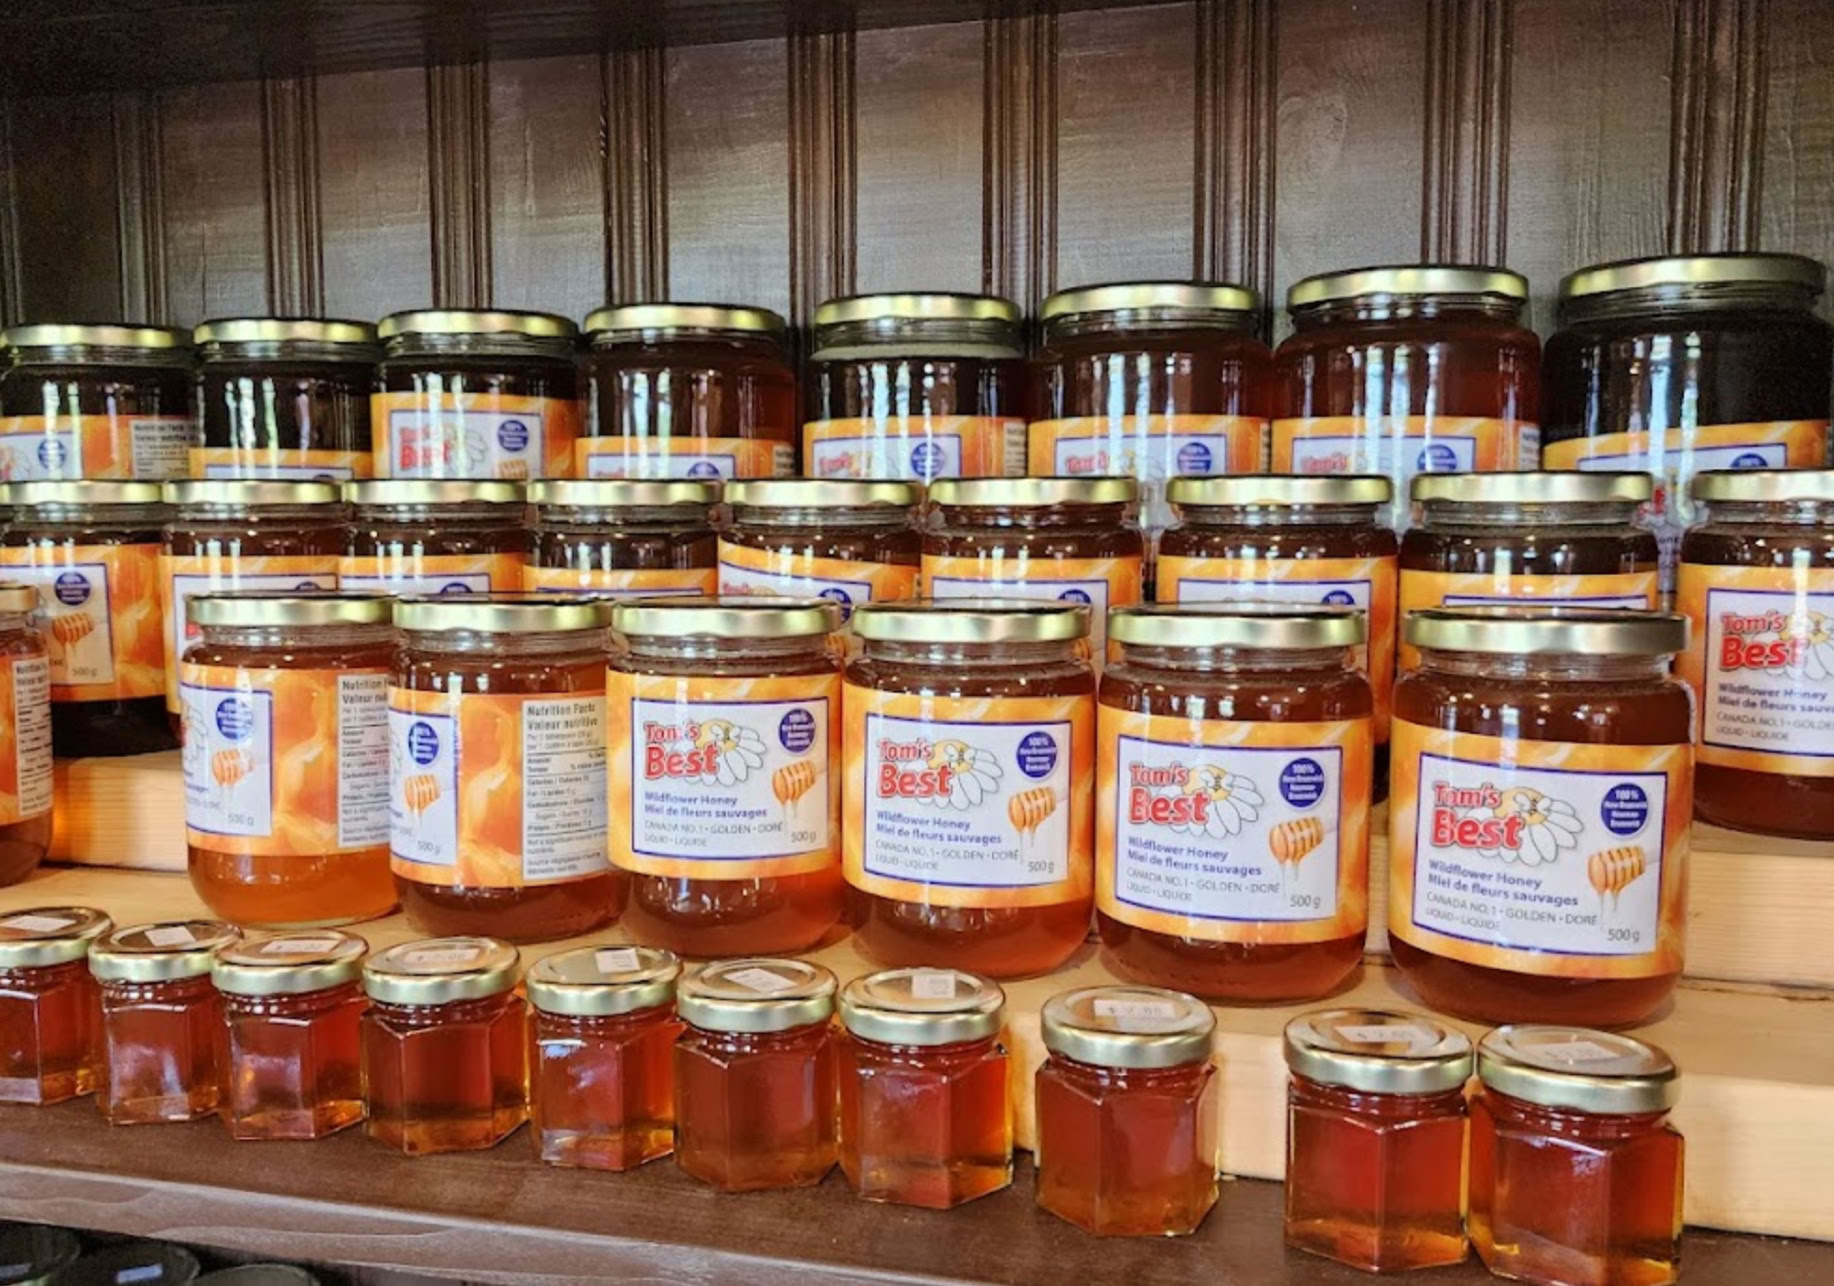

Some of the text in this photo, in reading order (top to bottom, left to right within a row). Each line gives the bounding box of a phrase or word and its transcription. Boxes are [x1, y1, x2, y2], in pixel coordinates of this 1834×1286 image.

[1720, 610, 1786, 634] Tom's
[1719, 634, 1808, 670] Best
[1718, 683, 1827, 701] Wildflower Hney
[1718, 695, 1834, 712] Miel de fleurs sauv
[527, 703, 595, 716] Nutrition Facts
[1717, 711, 1756, 723] CANADA
[1793, 719, 1834, 730] GOLDE
[564, 716, 598, 728] nutritive
[878, 738, 932, 761] Tom's
[645, 744, 719, 779] Best
[877, 763, 953, 797] Best
[1129, 762, 1189, 786] Tom's
[645, 791, 738, 806] Wildflower Honey
[1433, 781, 1501, 807] Tom's
[1615, 789, 1639, 800] 100%
[645, 804, 768, 819] Miel de fleurs sauvages
[1128, 787, 1211, 825] Best
[645, 820, 679, 832] CANADA
[710, 824, 751, 834] GOLDEN
[877, 810, 970, 831] Wildflower Honey
[1432, 808, 1524, 848] Best
[877, 823, 1002, 847] Miel de fleurs sauvages
[876, 839, 909, 854] CANADA
[941, 849, 984, 860] GOLDEN
[1128, 836, 1228, 862] Wildflower Honey
[1028, 861, 1047, 872] 500
[1128, 849, 1262, 878] Miel de fleurs sauvages
[1429, 859, 1542, 890] Wildflower Honey
[1127, 867, 1162, 881] CANADA
[1196, 879, 1242, 892] GOLDEN
[1428, 873, 1578, 907] Miel de fleurs sauvages
[1290, 895, 1311, 907] 500
[1427, 891, 1467, 910] CANADA
[1506, 908, 1556, 923] GOLDEN
[1426, 907, 1453, 921] LIQUID
[1608, 929, 1630, 941] 500
